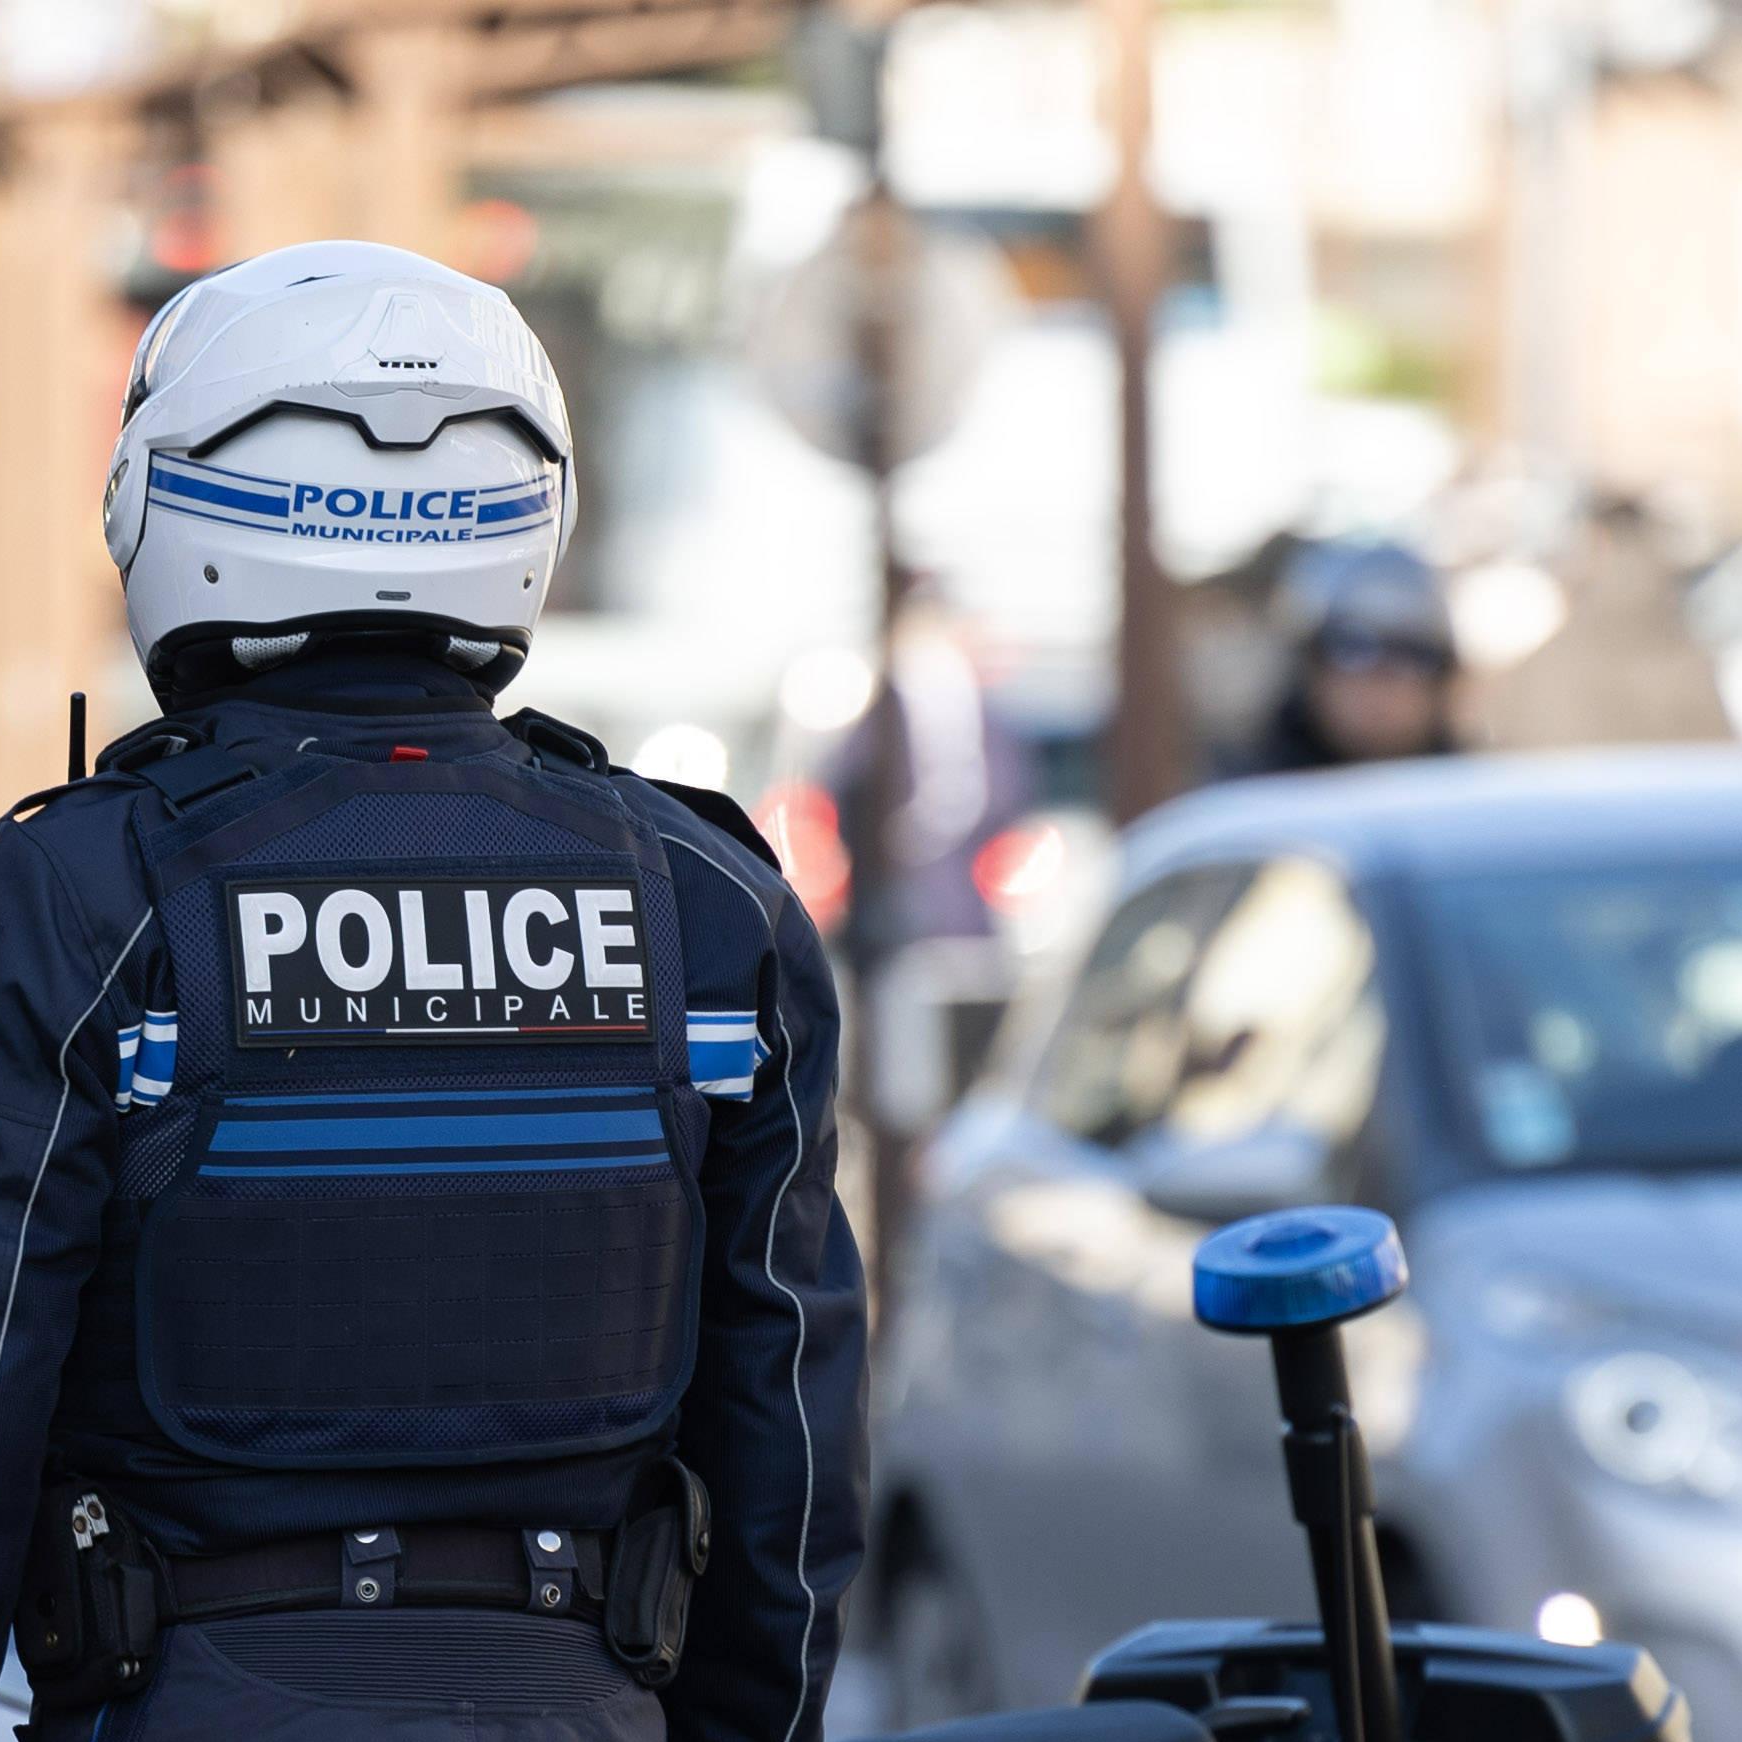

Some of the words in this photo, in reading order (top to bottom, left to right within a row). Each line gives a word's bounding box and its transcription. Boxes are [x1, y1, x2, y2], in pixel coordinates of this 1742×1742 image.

[294, 485, 476, 519] POLICE
[292, 523, 472, 542] MUNICIPALE
[238, 888, 644, 992] POLICE
[247, 994, 646, 1025] MUNICIPALE
